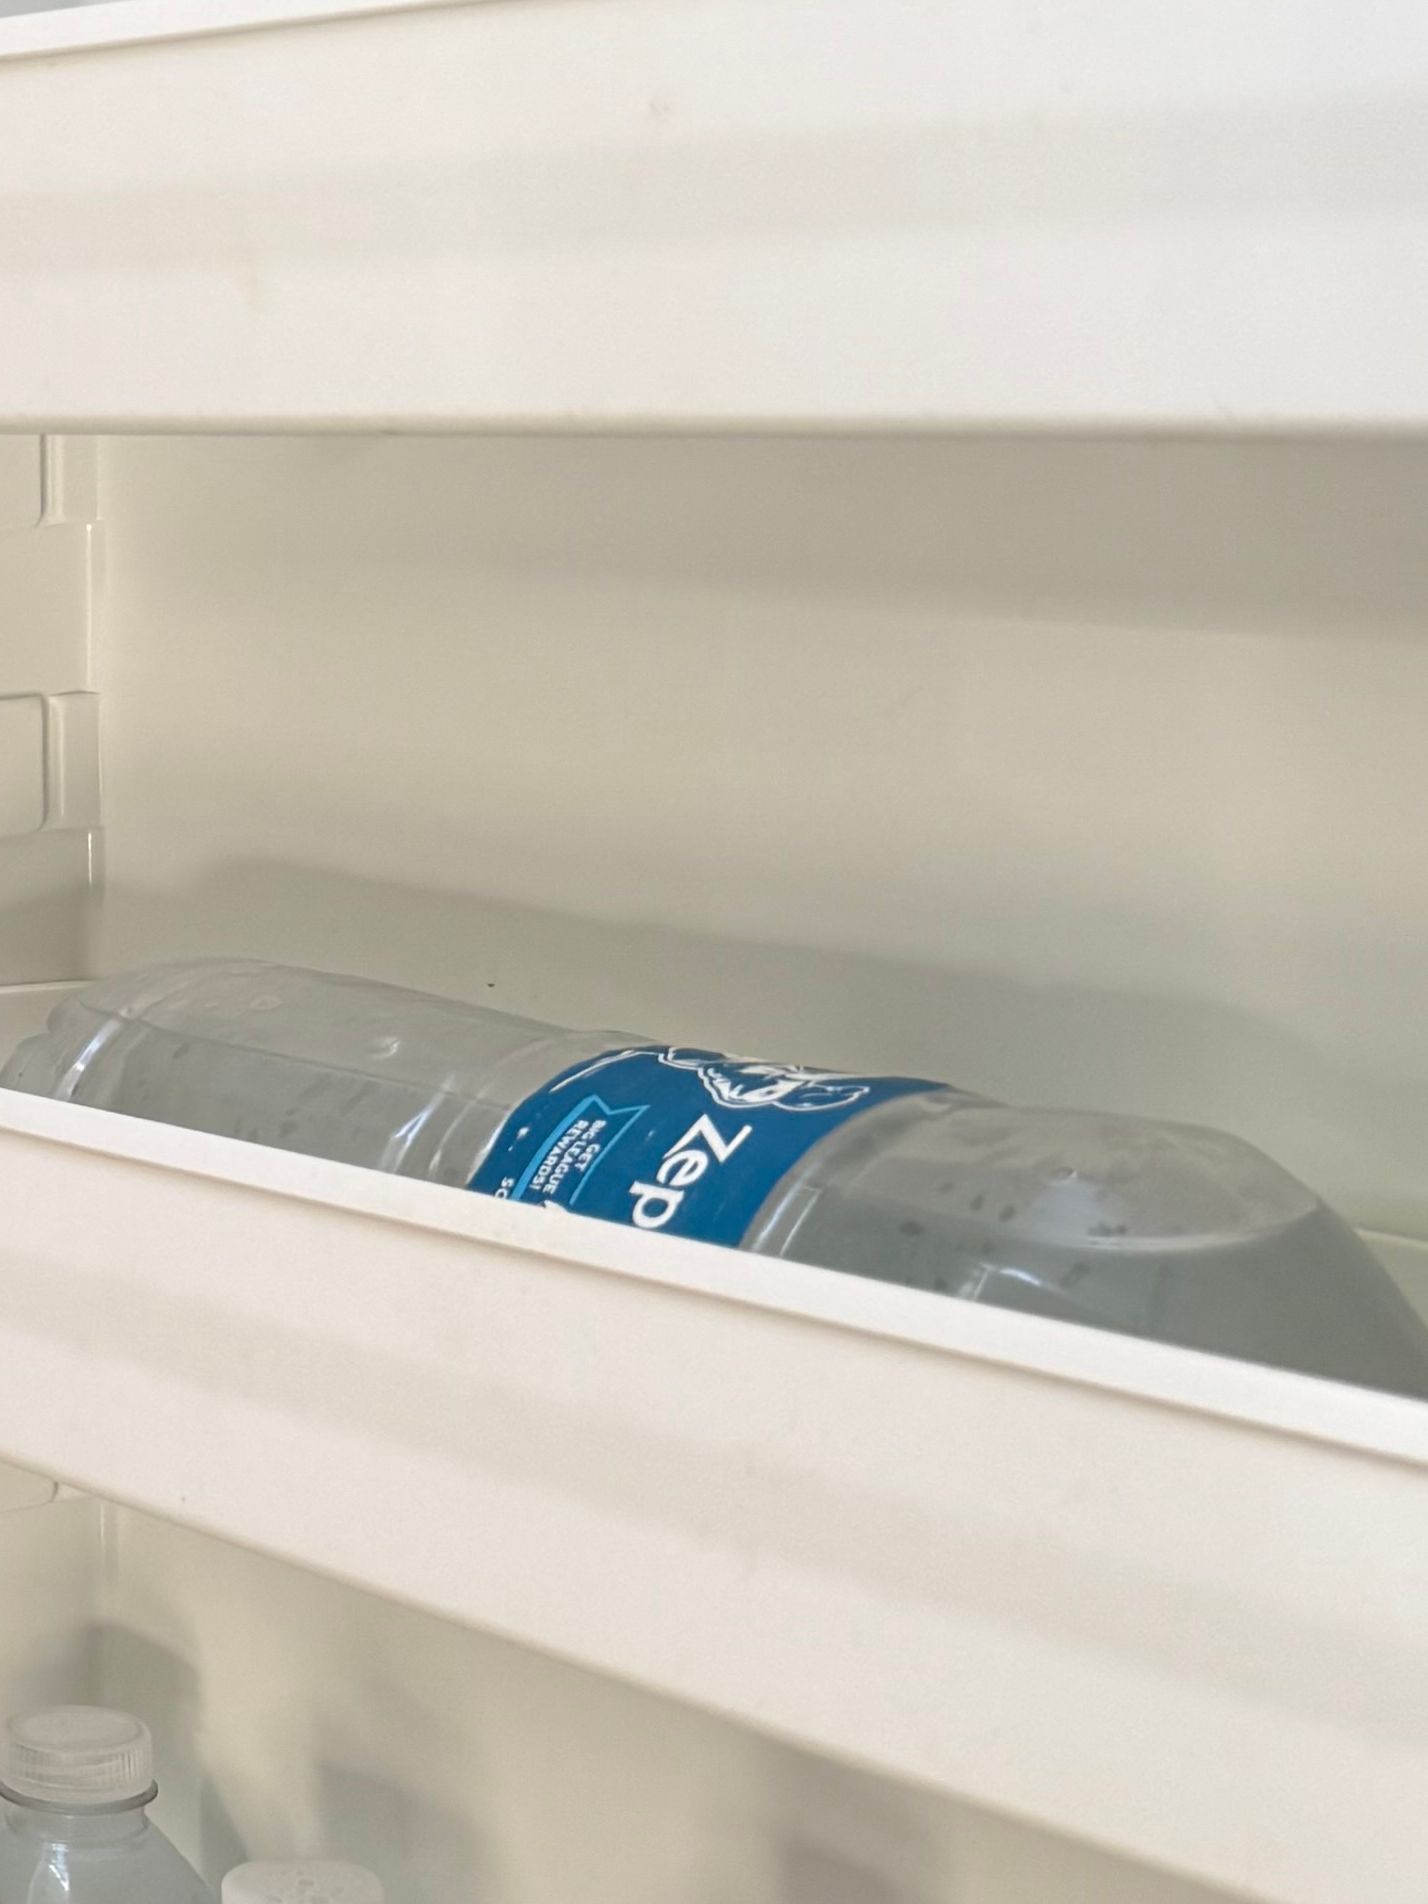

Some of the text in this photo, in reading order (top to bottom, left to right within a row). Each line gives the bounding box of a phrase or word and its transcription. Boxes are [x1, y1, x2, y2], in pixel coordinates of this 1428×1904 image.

[529, 1119, 589, 1190] REWARDS!
[542, 1119, 607, 1195] BIG LEAGUE
[574, 1143, 601, 1172] GET
[628, 1113, 753, 1229] Zep
